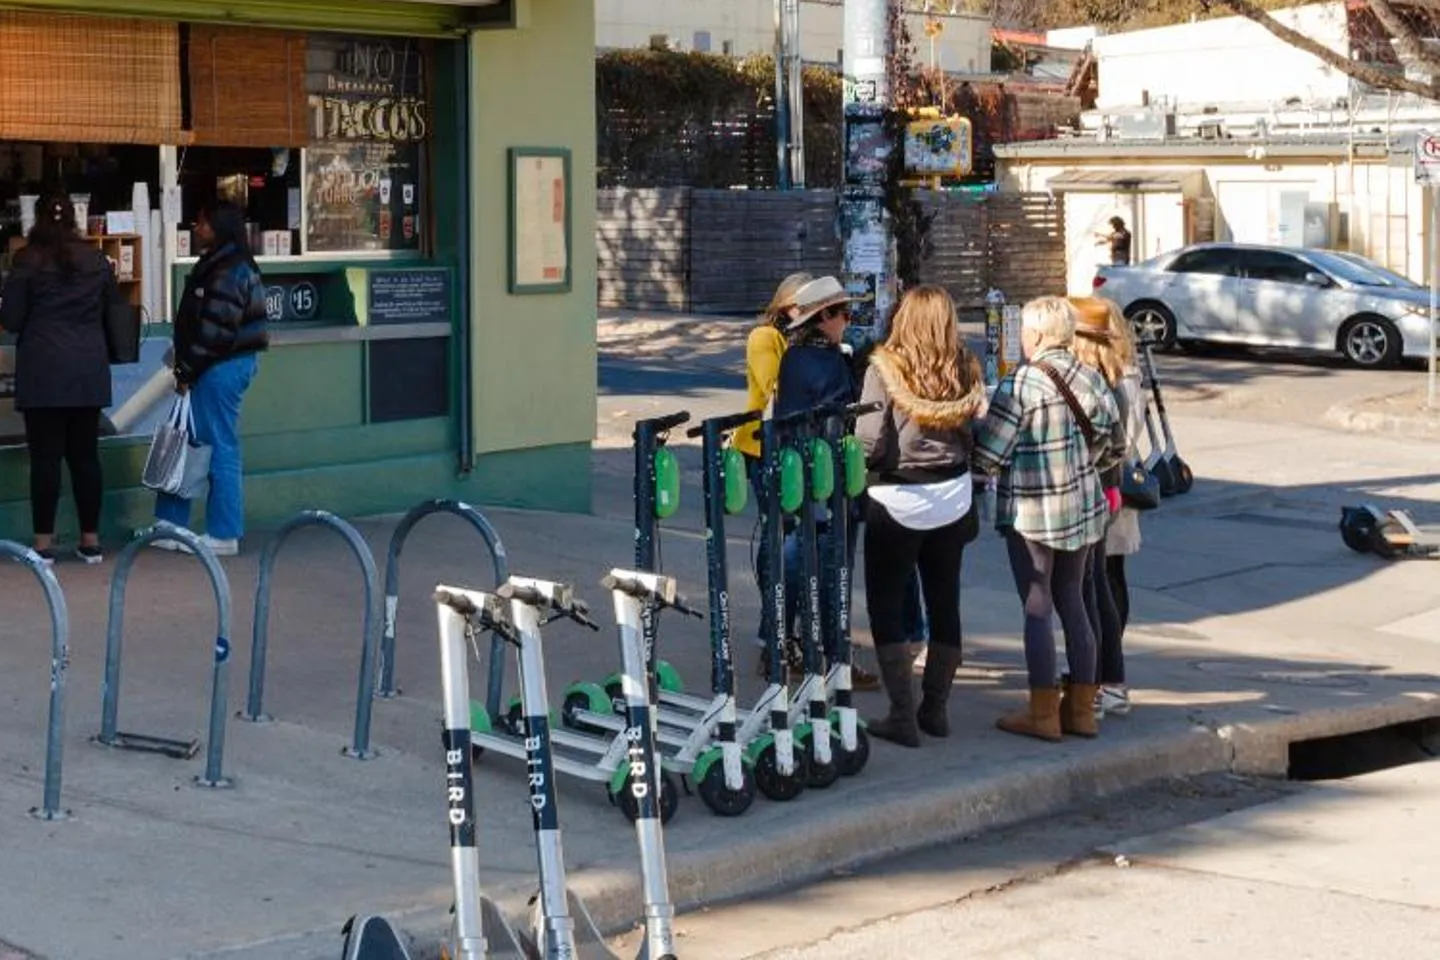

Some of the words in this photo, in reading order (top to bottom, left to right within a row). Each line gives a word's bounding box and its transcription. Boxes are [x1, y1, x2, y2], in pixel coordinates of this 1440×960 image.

[446, 748, 466, 825] BIRD
[524, 736, 547, 810] BIRD
[627, 725, 649, 799] BIRD
